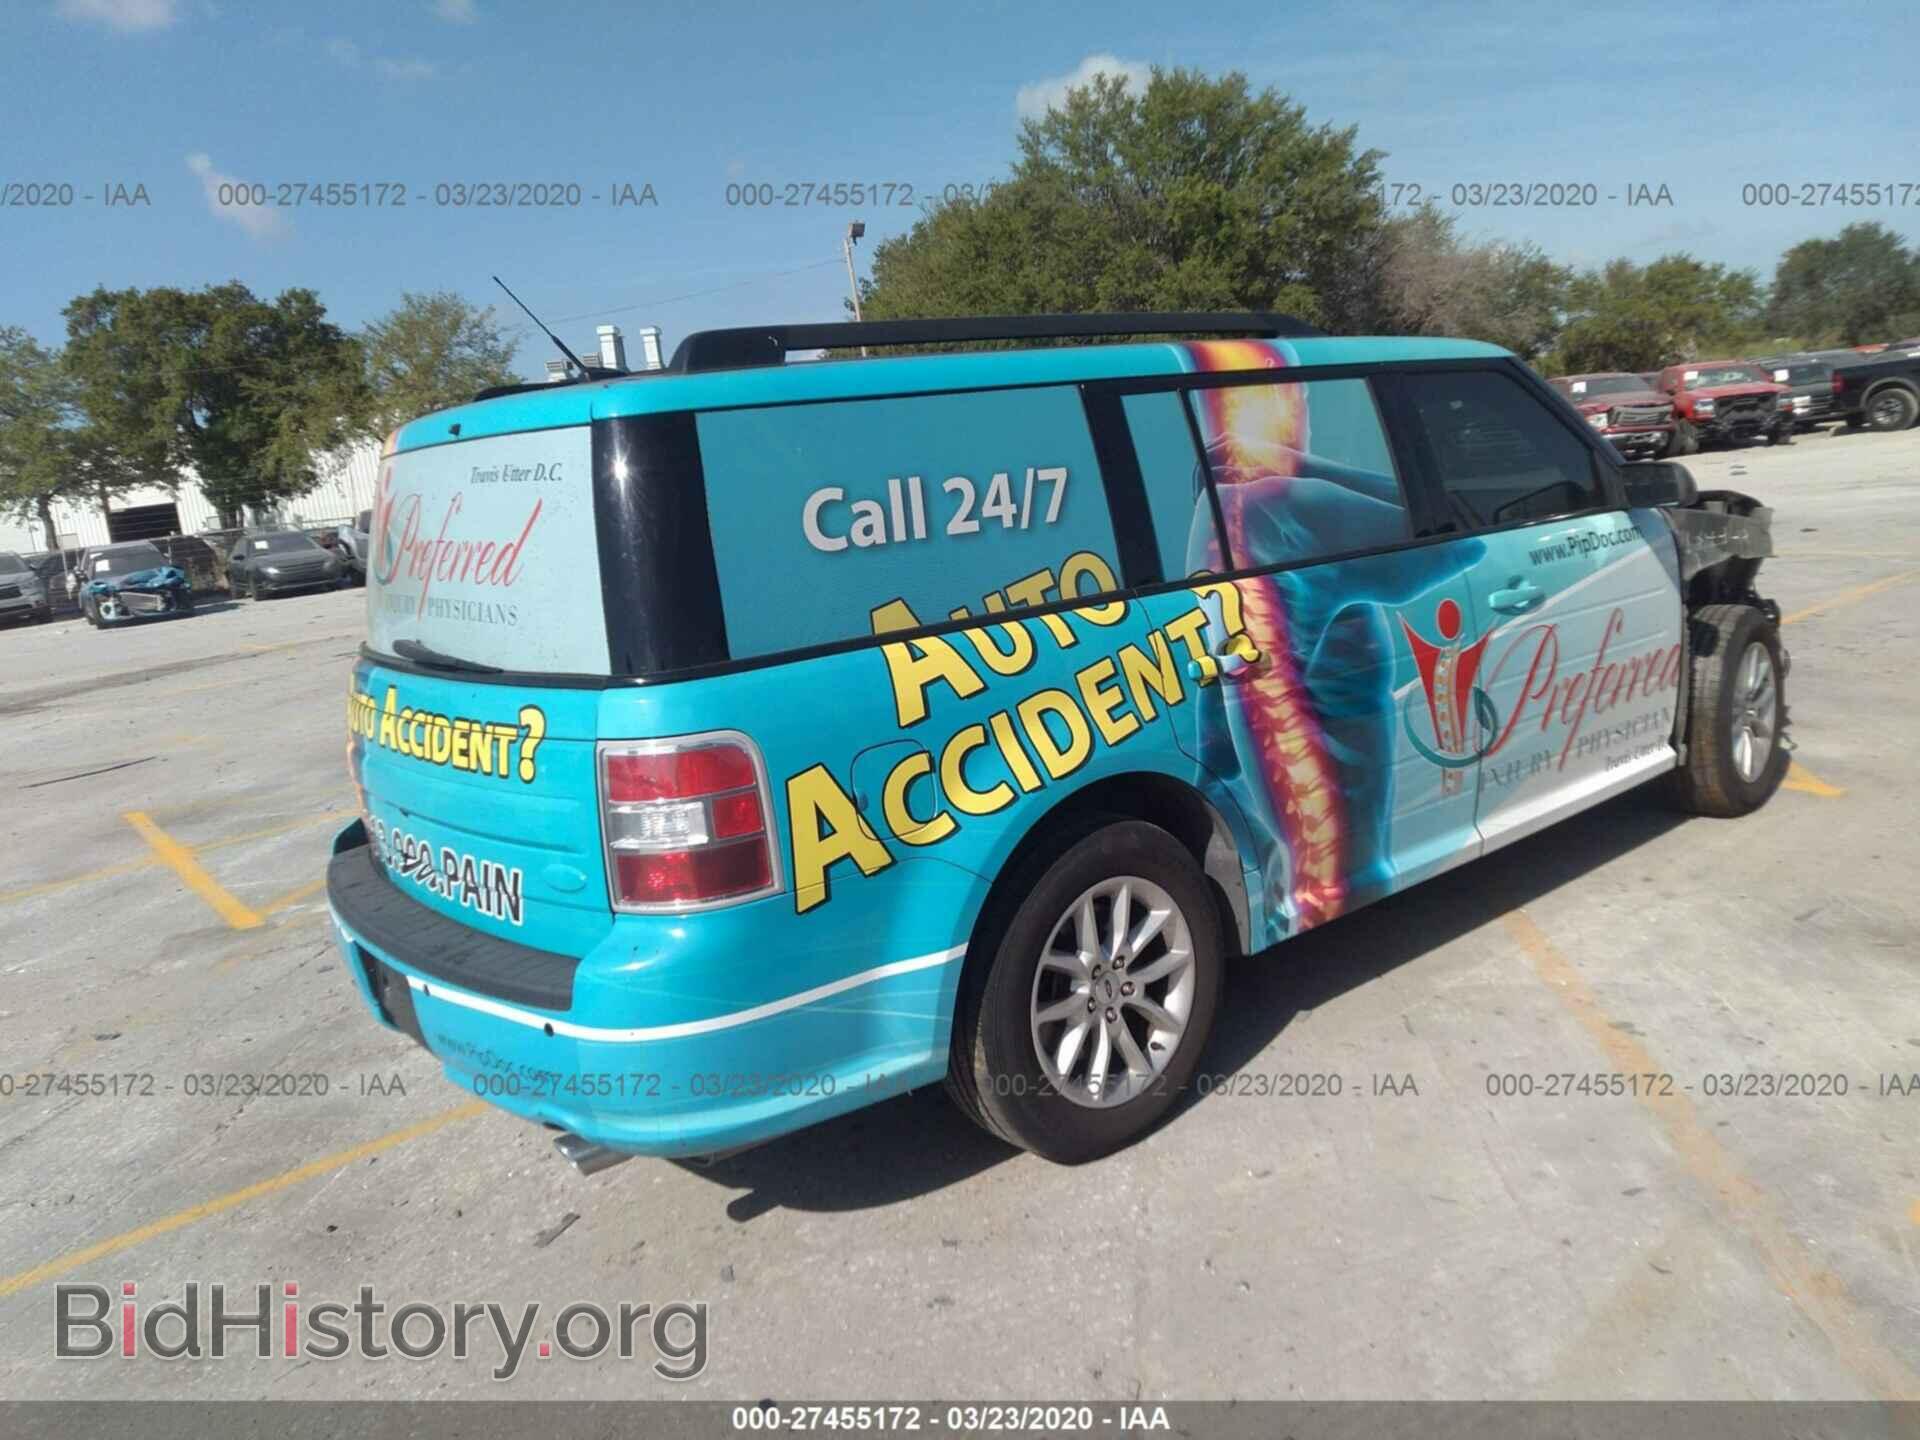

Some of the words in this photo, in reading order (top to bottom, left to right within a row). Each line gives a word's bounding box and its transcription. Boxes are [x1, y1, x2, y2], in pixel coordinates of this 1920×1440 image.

[533, 462, 563, 482] D.C.
[802, 476, 929, 552] Call
[942, 467, 1068, 536] 24/7
[389, 491, 546, 624] Preferred
[428, 596, 519, 627] PHYSICIANS
[870, 551, 1130, 728] AUTO
[378, 683, 547, 784] ACCIDENT?
